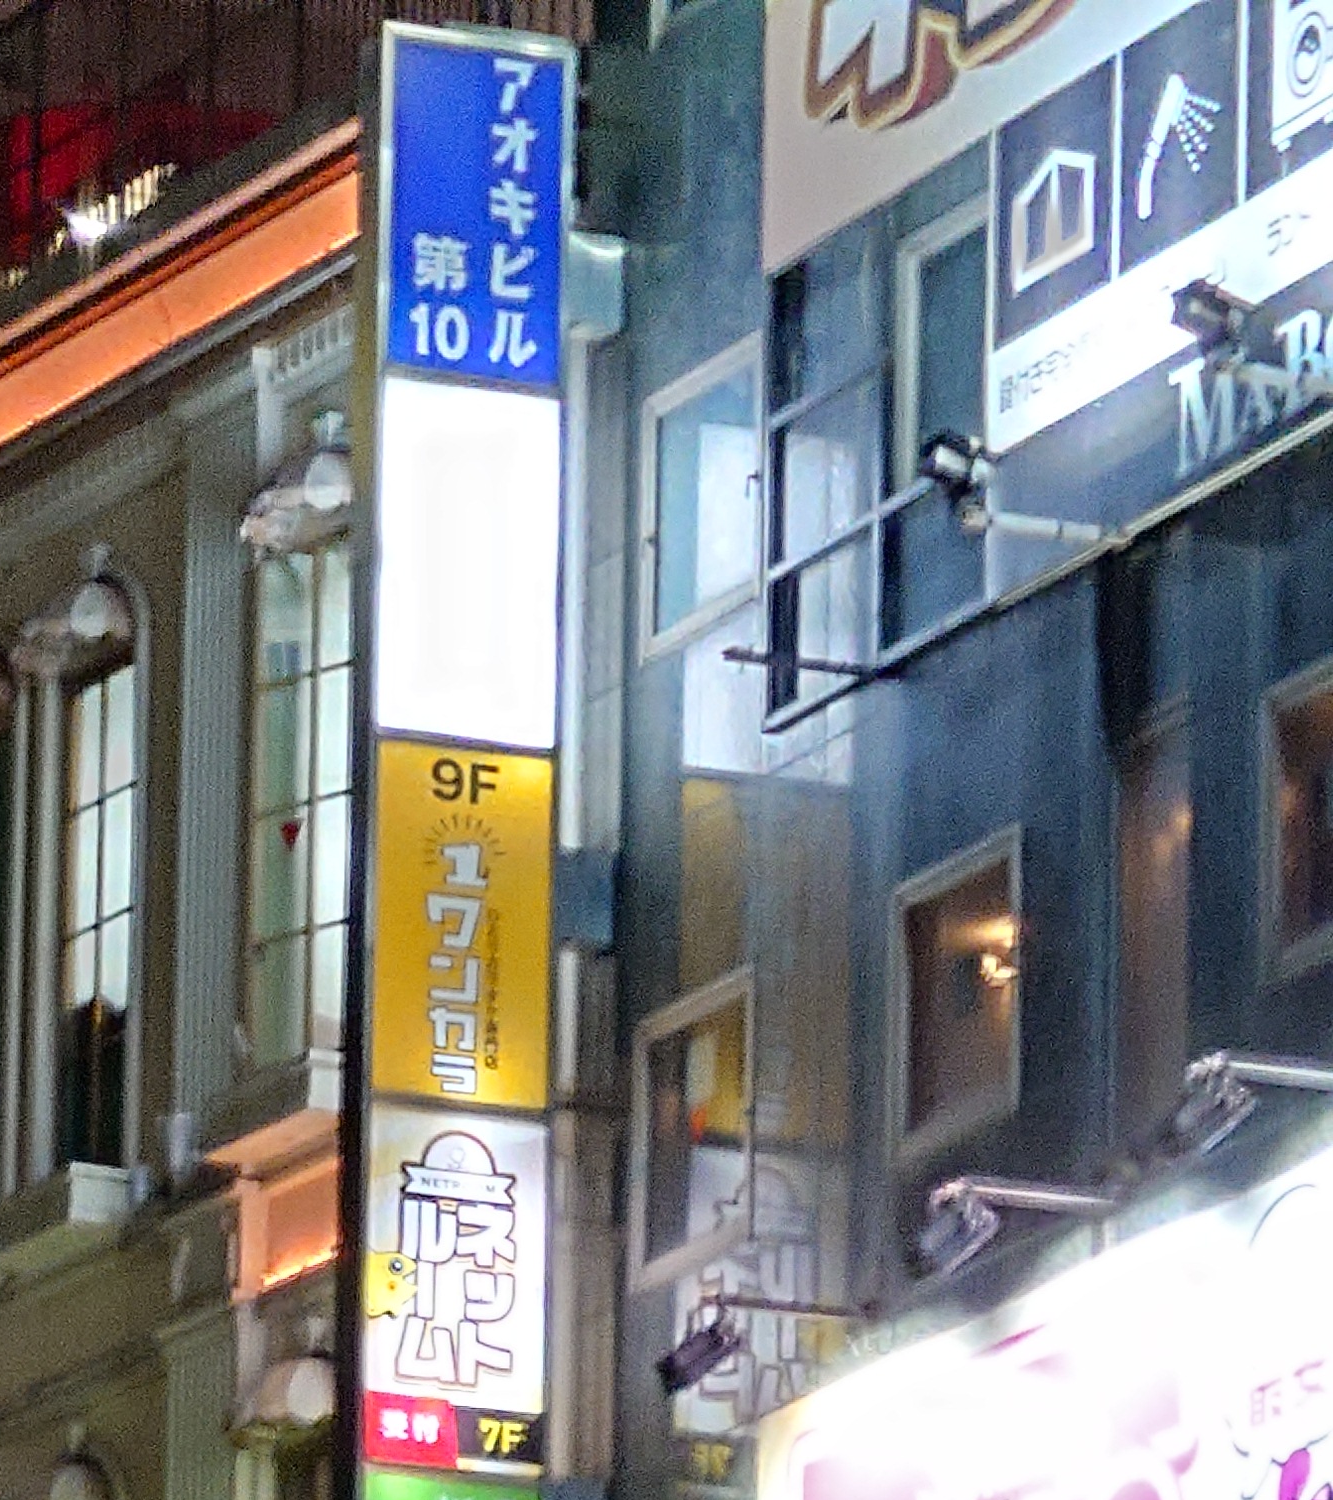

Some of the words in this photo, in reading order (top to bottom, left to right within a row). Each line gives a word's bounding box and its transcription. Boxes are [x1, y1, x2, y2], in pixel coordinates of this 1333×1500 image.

[489, 58, 538, 368] アオキビル
[431, 757, 499, 805] 9F
[478, 1417, 524, 1454] 7F
